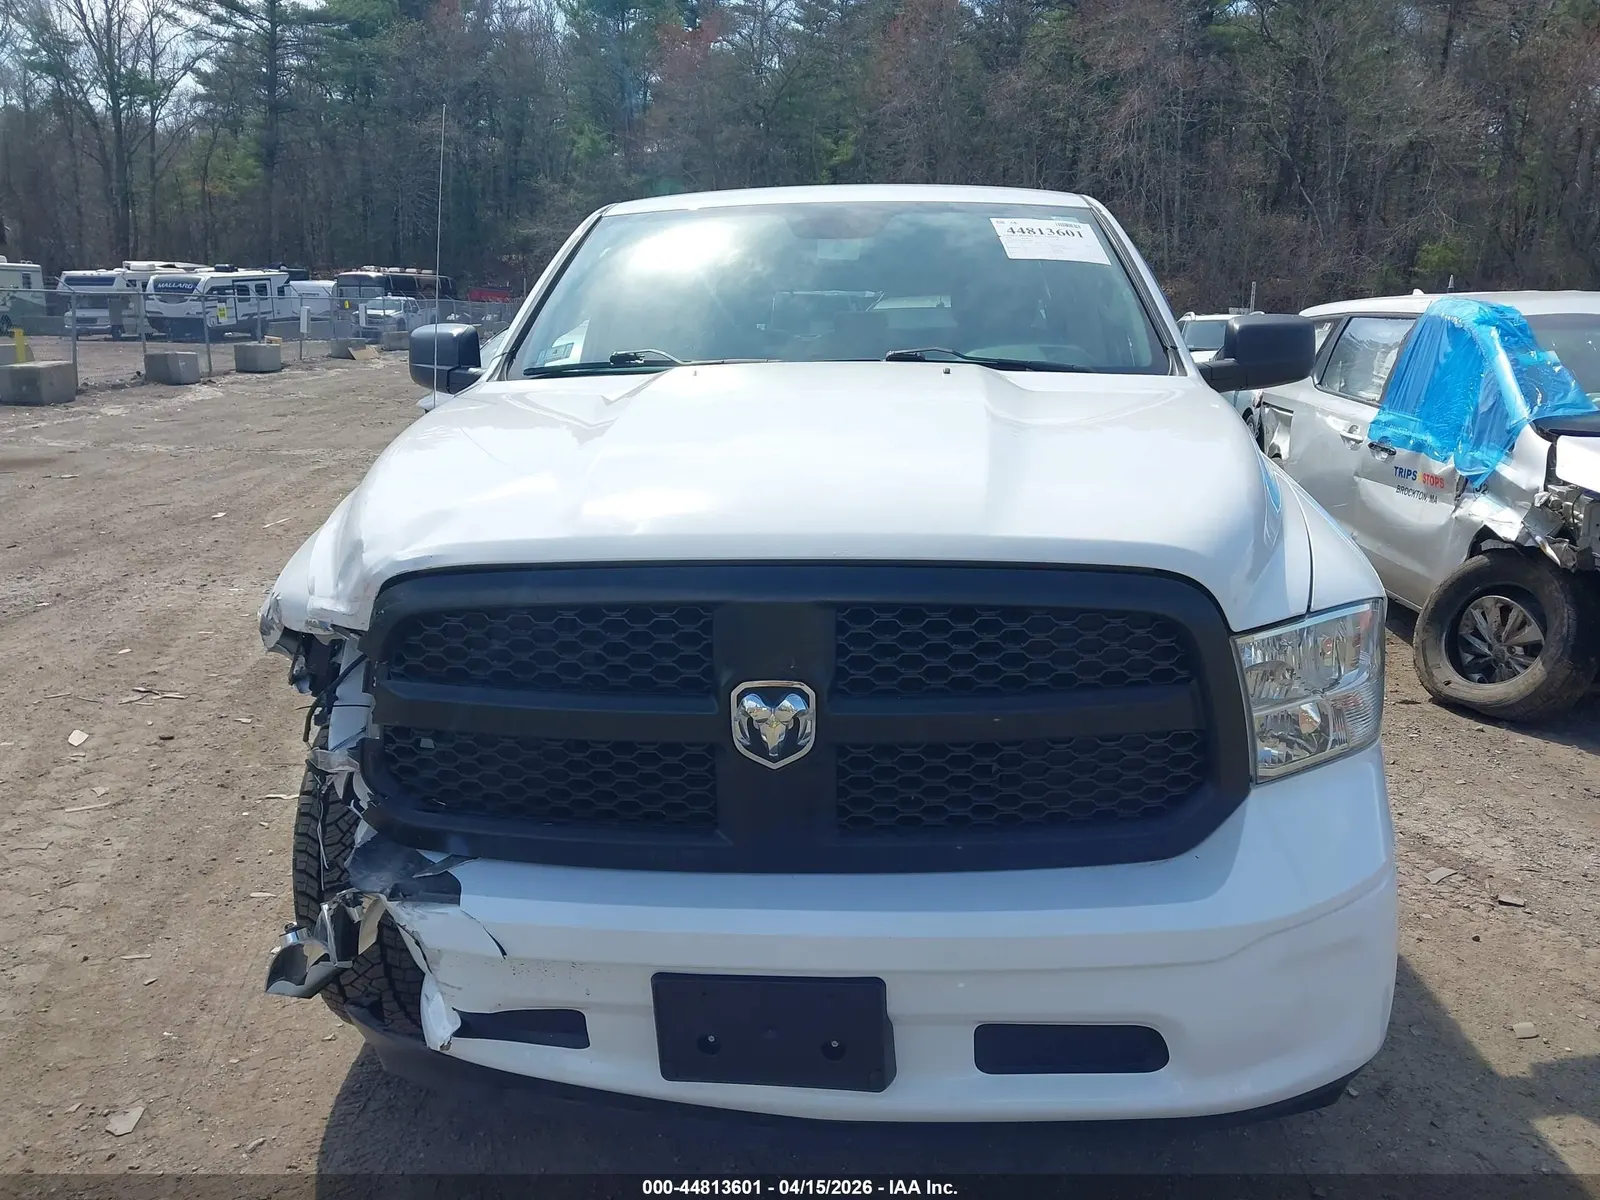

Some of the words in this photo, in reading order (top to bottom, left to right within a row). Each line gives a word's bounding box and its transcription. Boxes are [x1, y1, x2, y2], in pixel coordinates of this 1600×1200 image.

[1006, 226, 1084, 239] 44813601
[1393, 465, 1418, 481] TRIPS
[1422, 472, 1445, 489] STOPS
